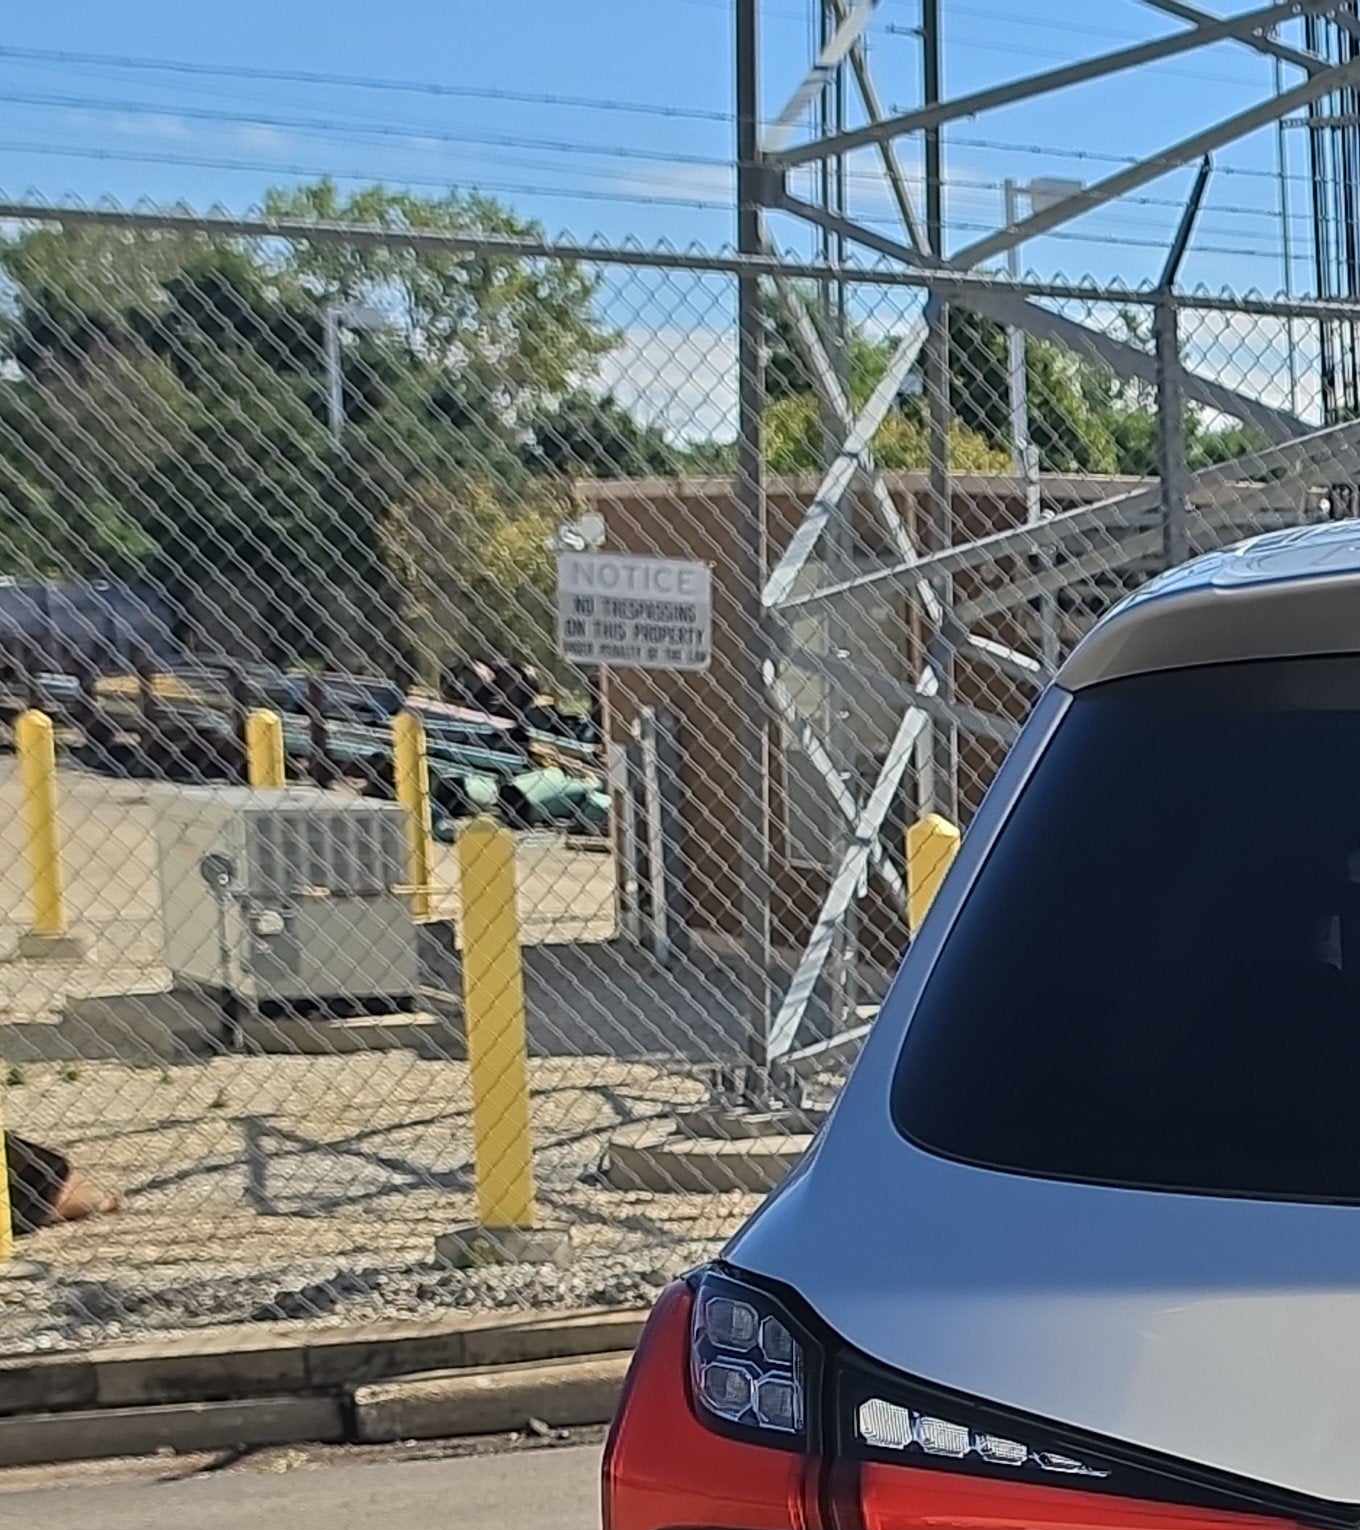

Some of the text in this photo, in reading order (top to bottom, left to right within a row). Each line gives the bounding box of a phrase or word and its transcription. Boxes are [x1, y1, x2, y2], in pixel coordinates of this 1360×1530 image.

[572, 561, 696, 595] NOTICE
[594, 621, 627, 641] THIS
[634, 624, 703, 646] PROPERTY
